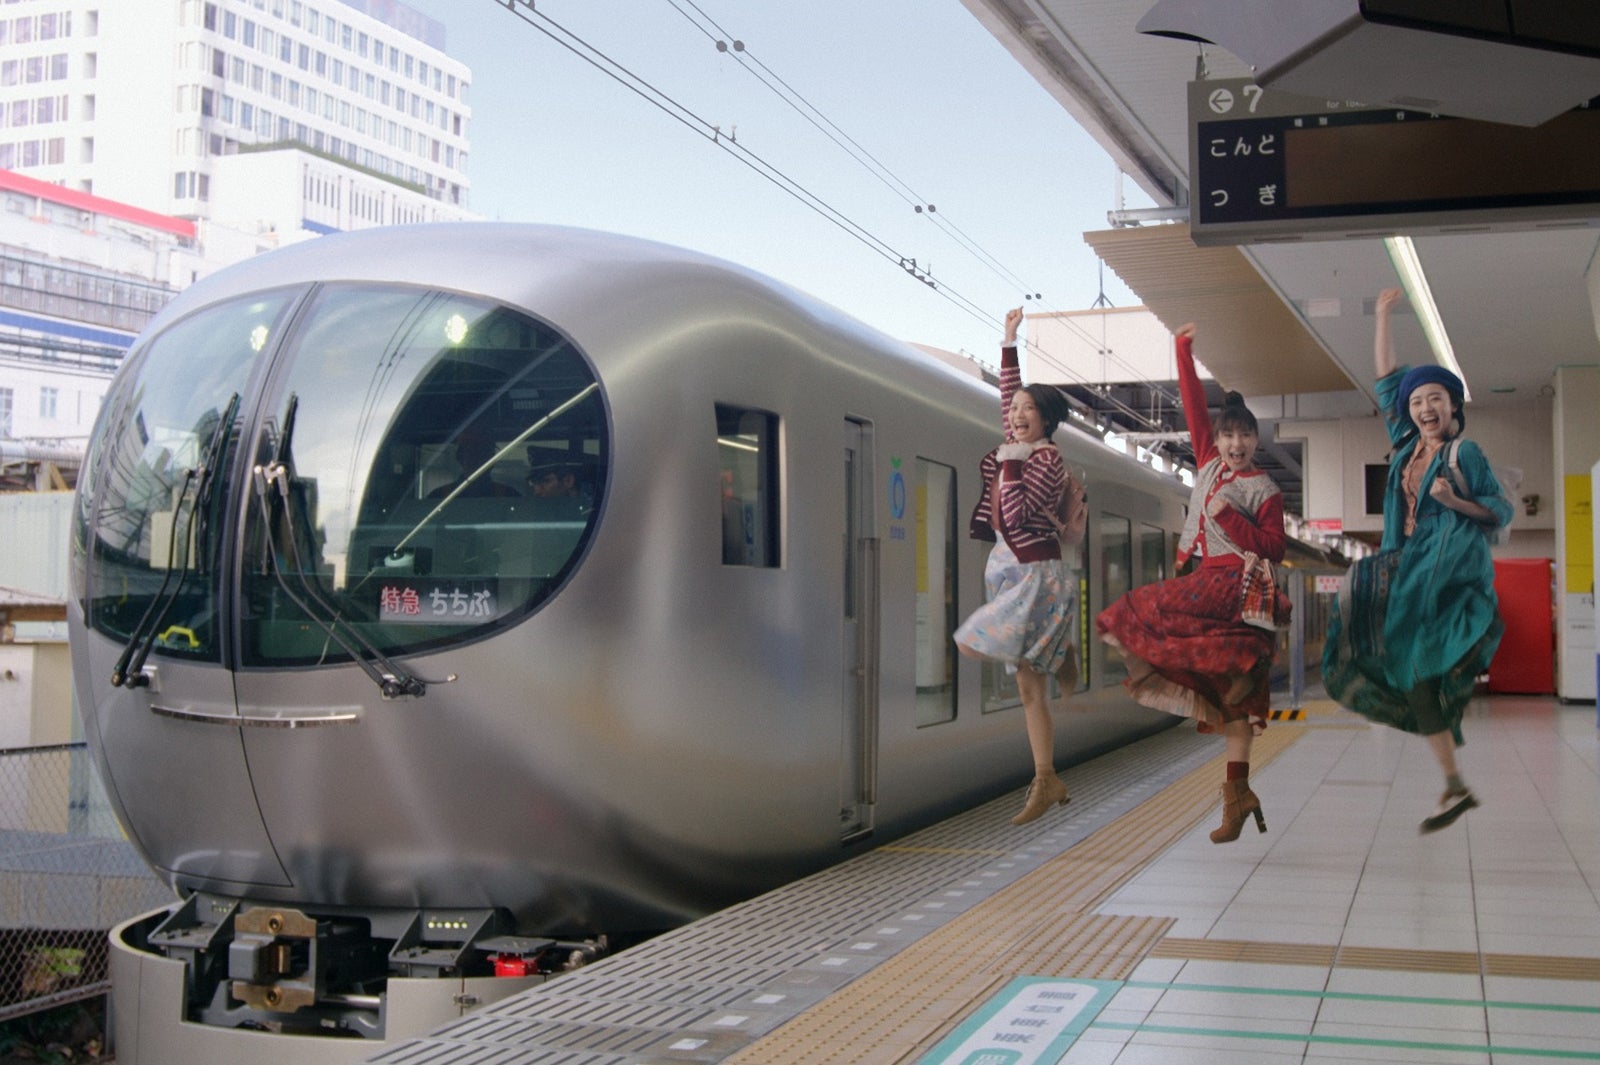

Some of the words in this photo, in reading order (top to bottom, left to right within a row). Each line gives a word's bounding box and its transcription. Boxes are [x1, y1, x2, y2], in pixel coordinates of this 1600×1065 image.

[1243, 85, 1263, 113] 7
[1211, 134, 1275, 157] こんど
[381, 586, 421, 614] 特急
[429, 587, 491, 617] ちちぶ
